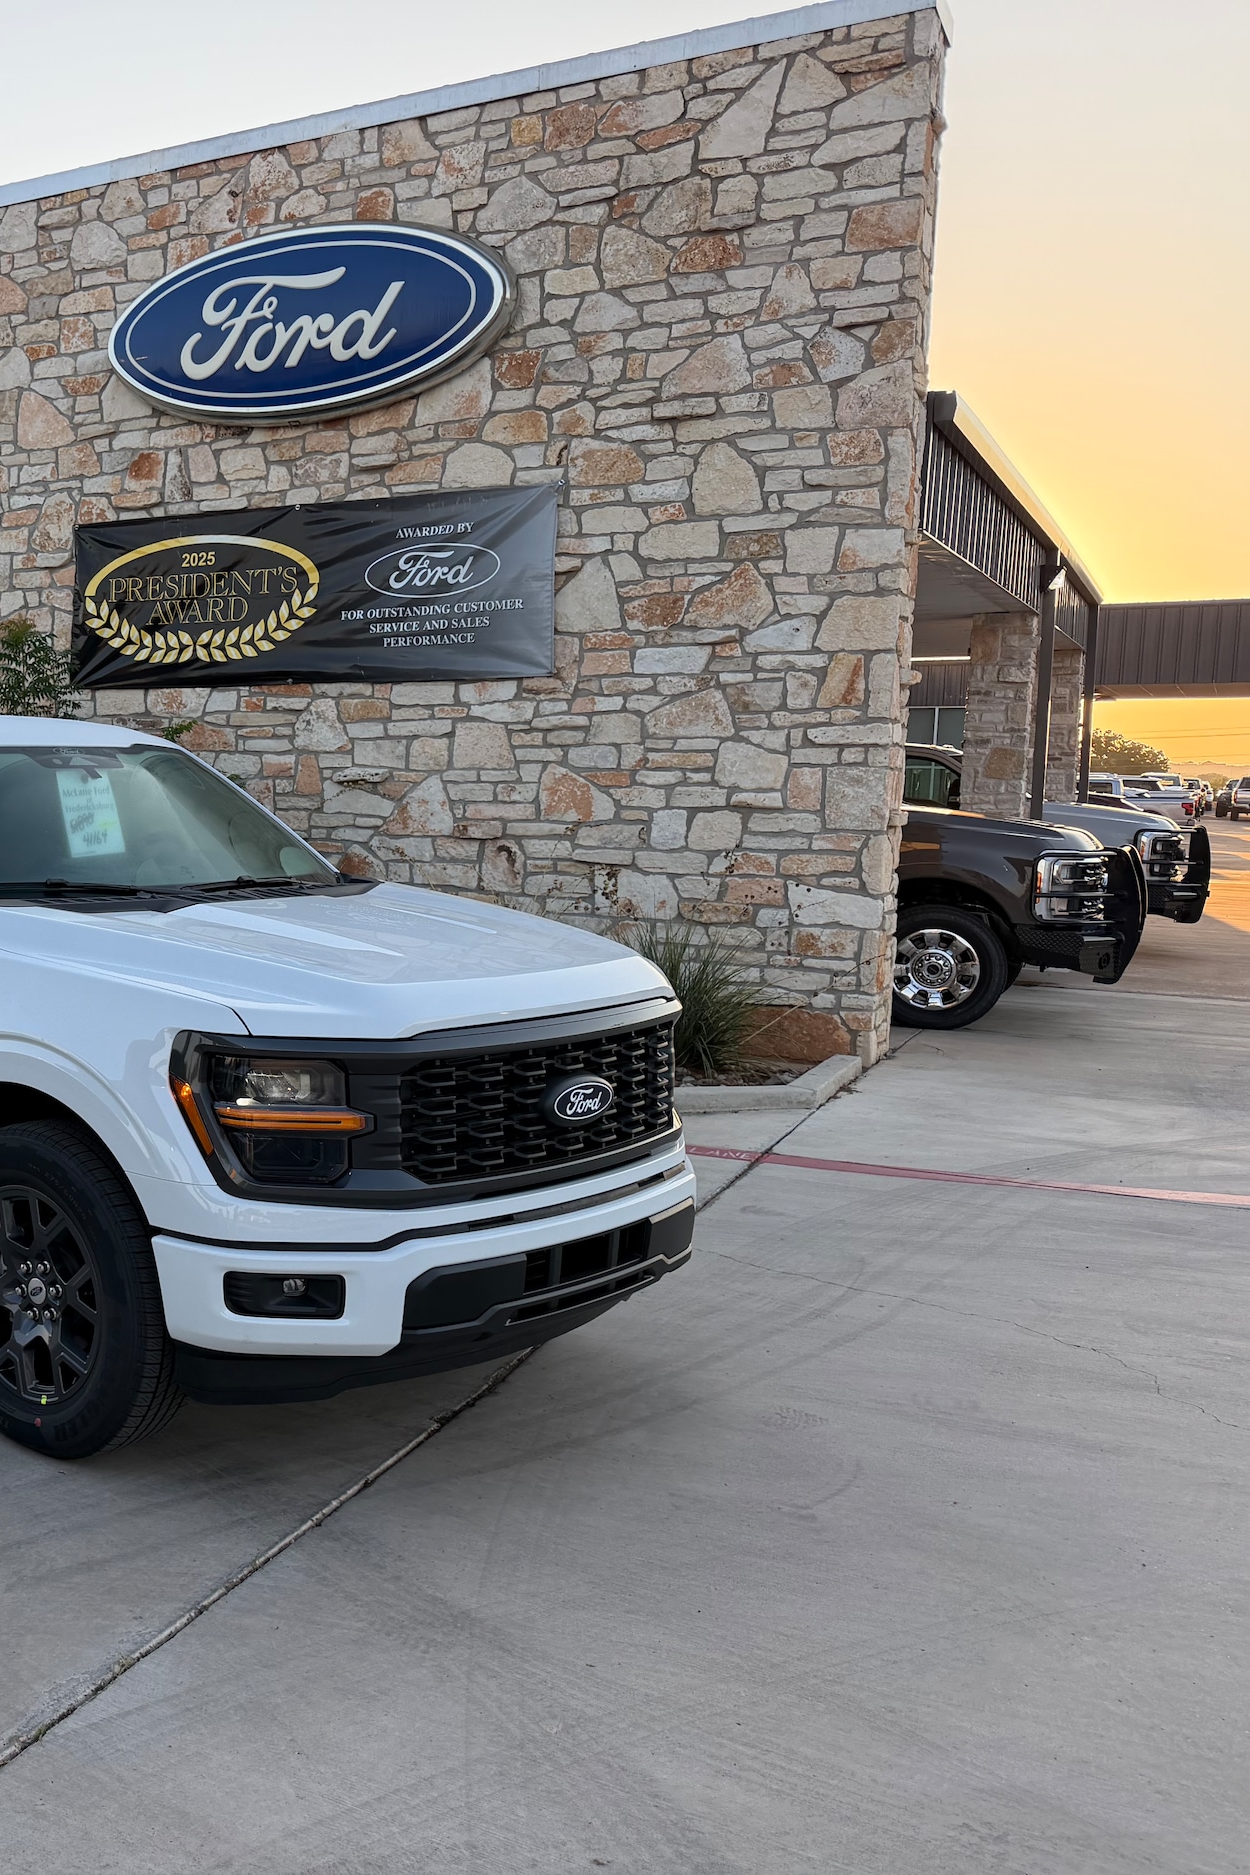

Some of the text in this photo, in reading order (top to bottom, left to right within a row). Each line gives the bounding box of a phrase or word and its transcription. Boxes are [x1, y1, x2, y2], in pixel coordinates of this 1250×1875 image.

[180, 266, 405, 381] Ford
[395, 522, 474, 539] AWARDED BY
[181, 552, 216, 567] 2025
[389, 550, 474, 589] Ford
[108, 566, 298, 603] PRESIDENT'S
[146, 597, 249, 626] AWARD
[340, 599, 525, 621] FOR OUTSTANDING CUSTOMER
[369, 616, 490, 634] SERVICE AND SALES
[383, 633, 476, 648] PERFORMANCE
[62, 785, 111, 798] McLane Ford
[566, 1088, 603, 1115] Ford
